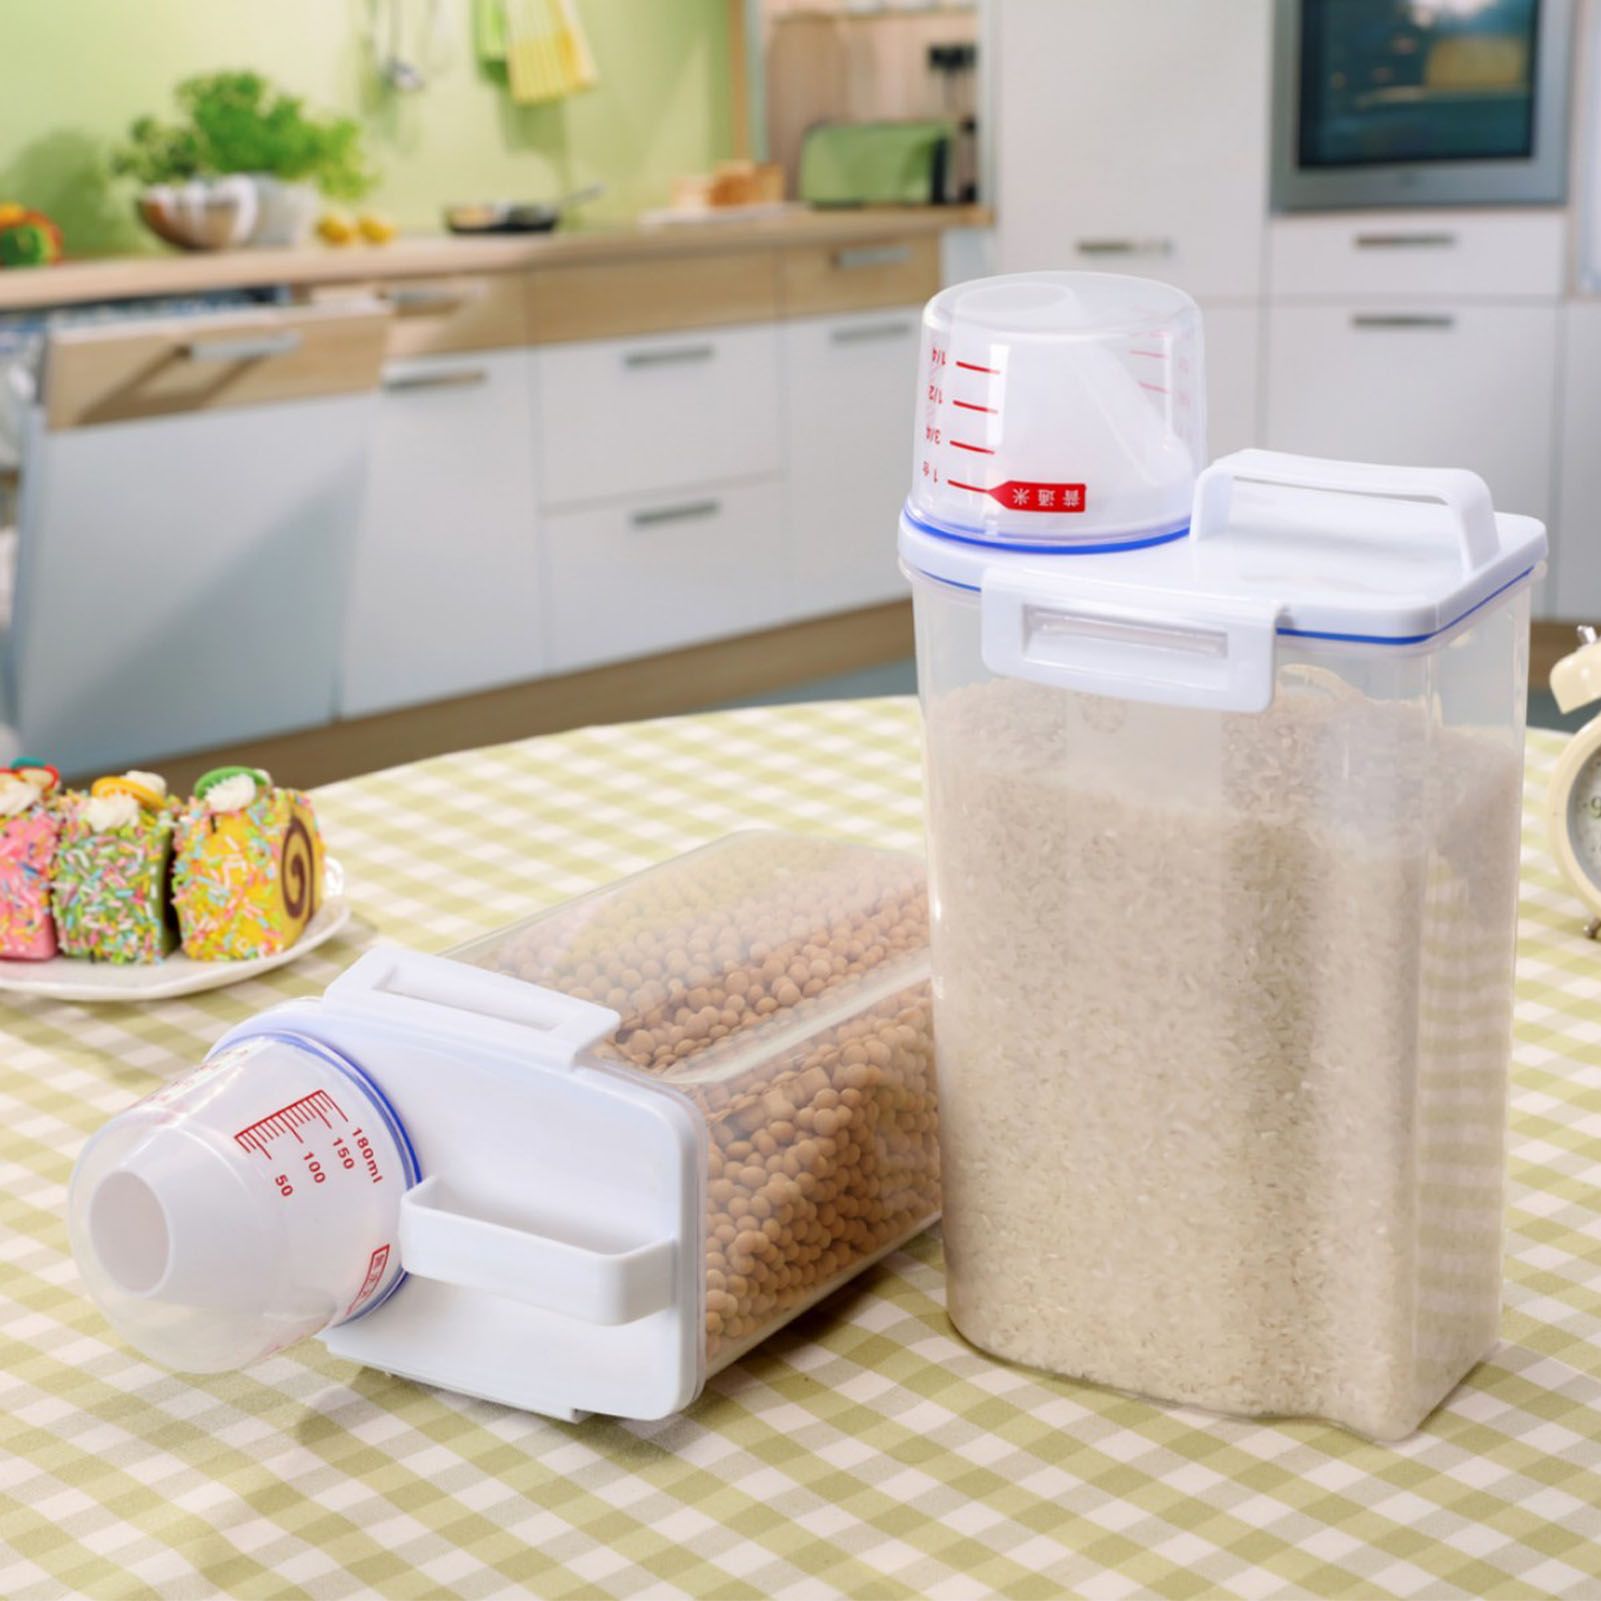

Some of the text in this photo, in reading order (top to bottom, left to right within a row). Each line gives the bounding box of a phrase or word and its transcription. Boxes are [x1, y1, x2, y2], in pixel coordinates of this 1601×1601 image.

[932, 347, 946, 366] 1/4
[928, 385, 943, 404] 1/2
[926, 426, 941, 445] 3/4
[1012, 489, 1080, 507] 普通米
[332, 1137, 355, 1170] 150
[352, 1127, 383, 1184] 180ml
[303, 1151, 326, 1184] 100
[275, 1174, 294, 1197] 50
